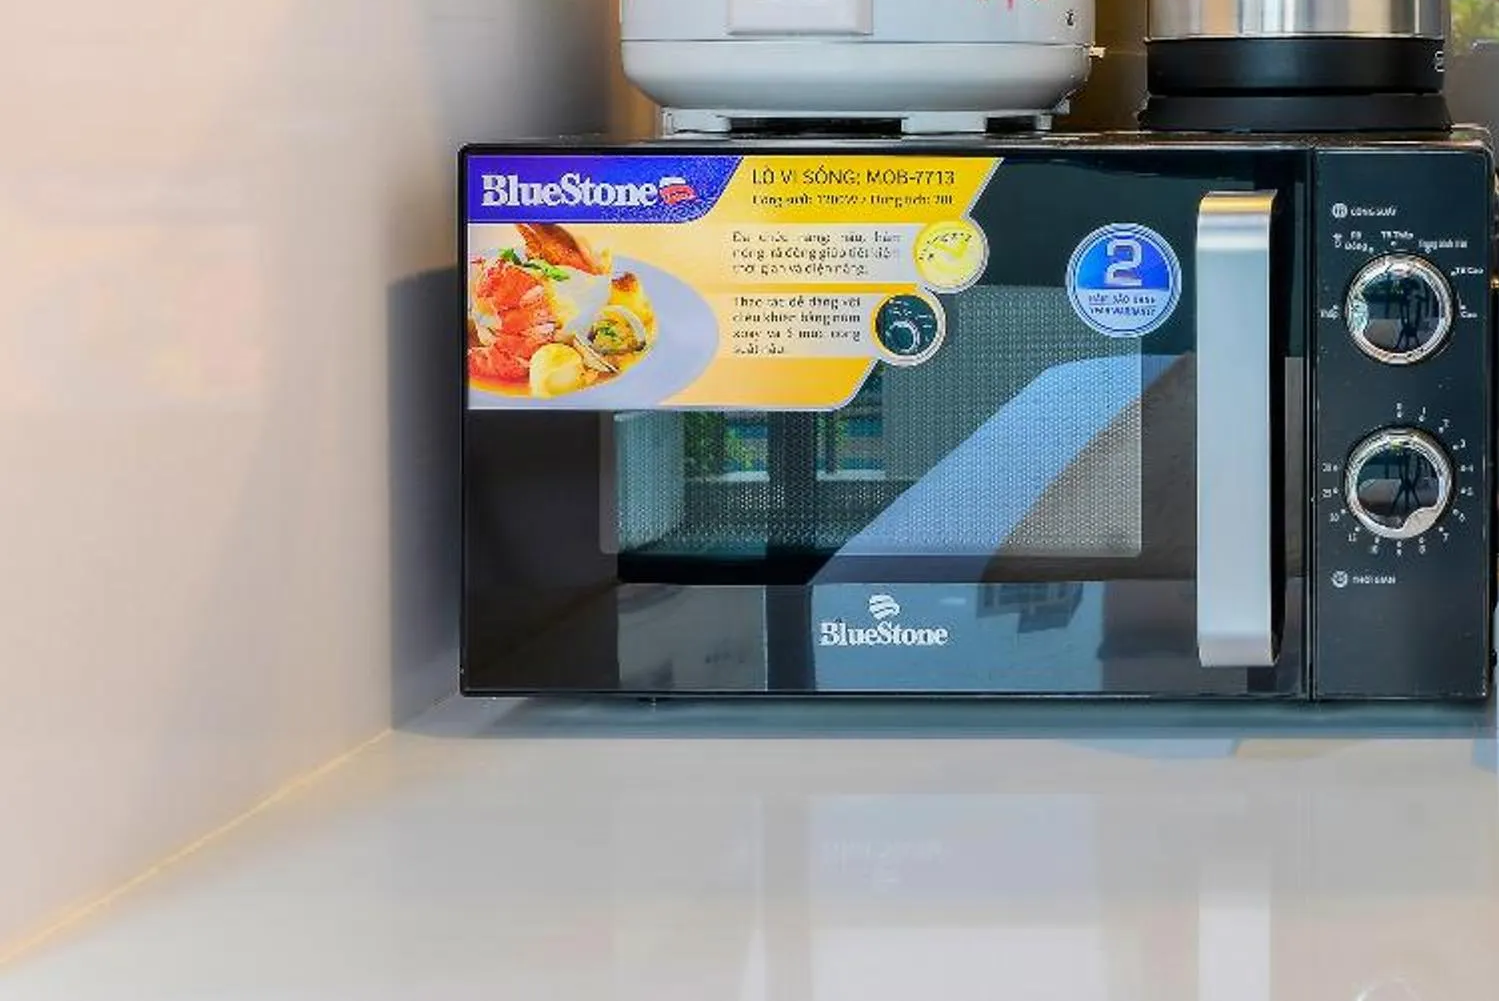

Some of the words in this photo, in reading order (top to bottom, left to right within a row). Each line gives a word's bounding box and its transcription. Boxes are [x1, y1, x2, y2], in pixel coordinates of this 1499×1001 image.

[480, 172, 658, 208] BlueStone
[866, 168, 956, 186] MOB-7713
[1103, 238, 1143, 287] 2
[818, 620, 949, 647] BlueStone
